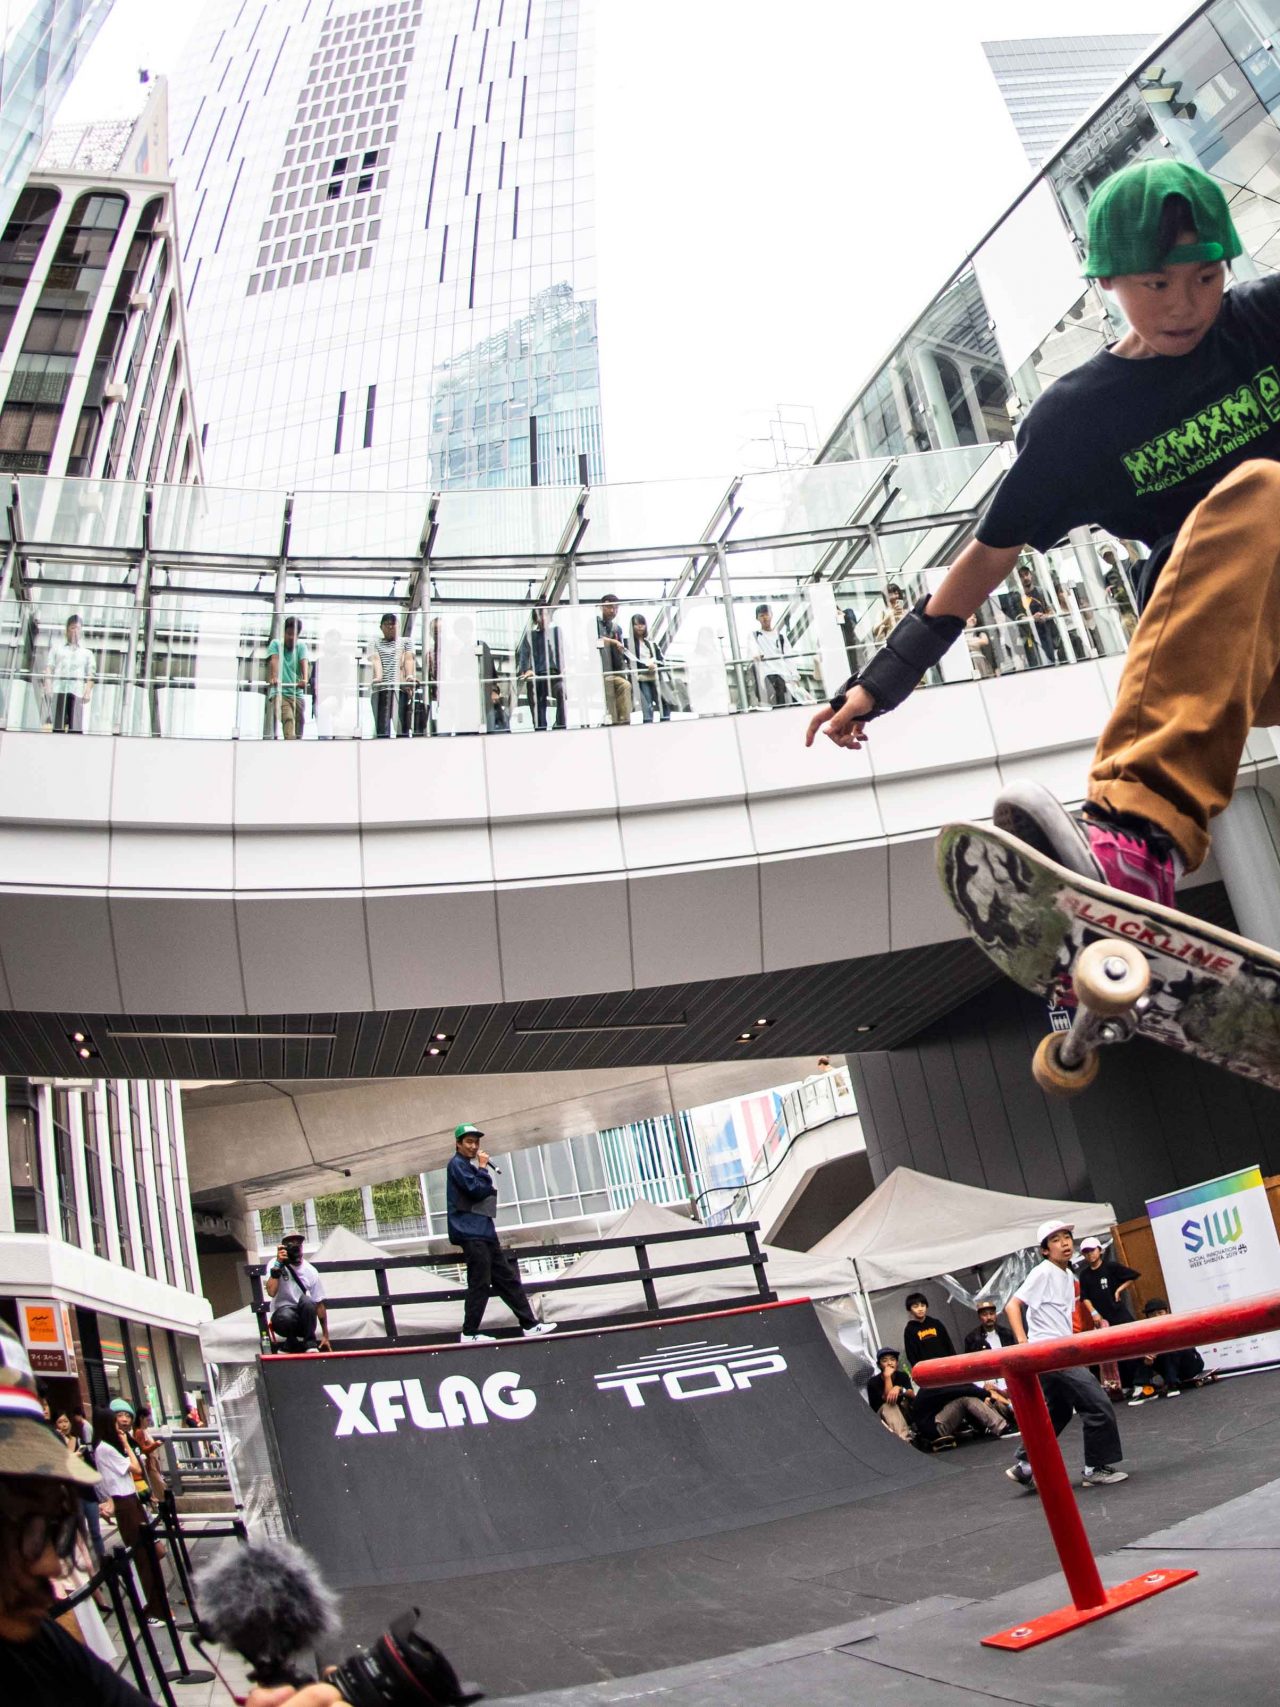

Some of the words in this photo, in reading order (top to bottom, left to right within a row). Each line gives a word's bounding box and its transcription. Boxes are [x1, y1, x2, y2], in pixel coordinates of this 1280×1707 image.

[1136, 473, 1186, 497] MAGICAL
[1187, 450, 1222, 475] MOSH
[1223, 422, 1270, 454] MISFITS
[1181, 1205, 1243, 1253] SIW
[1188, 1254, 1206, 1263] SOCIAL
[1206, 1246, 1237, 1259] INNOVATION
[1189, 1260, 1203, 1269] WEEK
[1203, 1255, 1225, 1266] SHIBUYA
[1225, 1251, 1239, 1260] 2019
[323, 1371, 537, 1436] XFLAG
[596, 1354, 787, 1408] TOP
